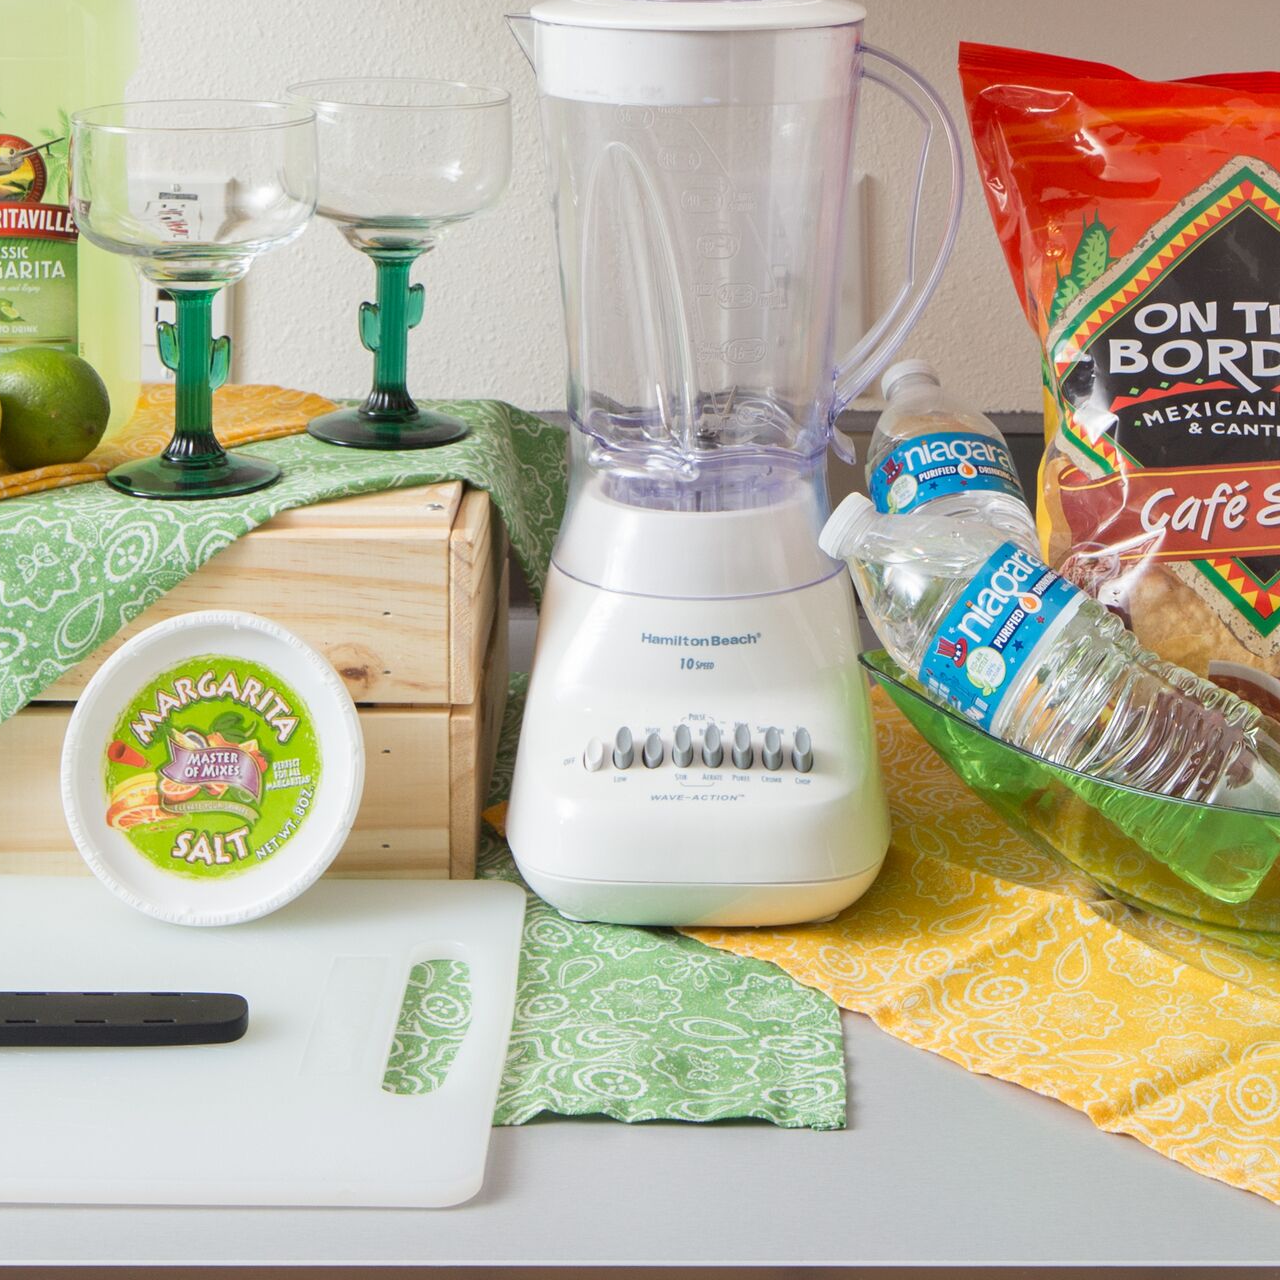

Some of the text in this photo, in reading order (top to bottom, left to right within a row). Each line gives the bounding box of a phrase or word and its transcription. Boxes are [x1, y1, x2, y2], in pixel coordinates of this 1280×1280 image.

[1133, 301, 1218, 335] ON
[12, 325, 38, 333] DRINK
[1142, 400, 1276, 428] MEXICAN
[1188, 422, 1203, 435] &
[904, 439, 1015, 472] niagara
[918, 466, 956, 483] PURIFIED
[1139, 480, 1252, 540] Café
[957, 549, 1042, 643] niagara
[993, 609, 1025, 649] PURIFIED
[641, 632, 758, 647] Hamilton Beach
[680, 657, 715, 670] 10 SPEED
[129, 669, 300, 750] MARGARITA
[187, 752, 239, 767] MASTER
[563, 757, 576, 766] OFF
[184, 765, 240, 778] OF MIXES
[273, 768, 301, 780] FOR ALL
[650, 793, 738, 801] WAVE-ACTION
[171, 824, 250, 866] SALT
[255, 836, 280, 861] NET
[277, 818, 302, 841] WT.
